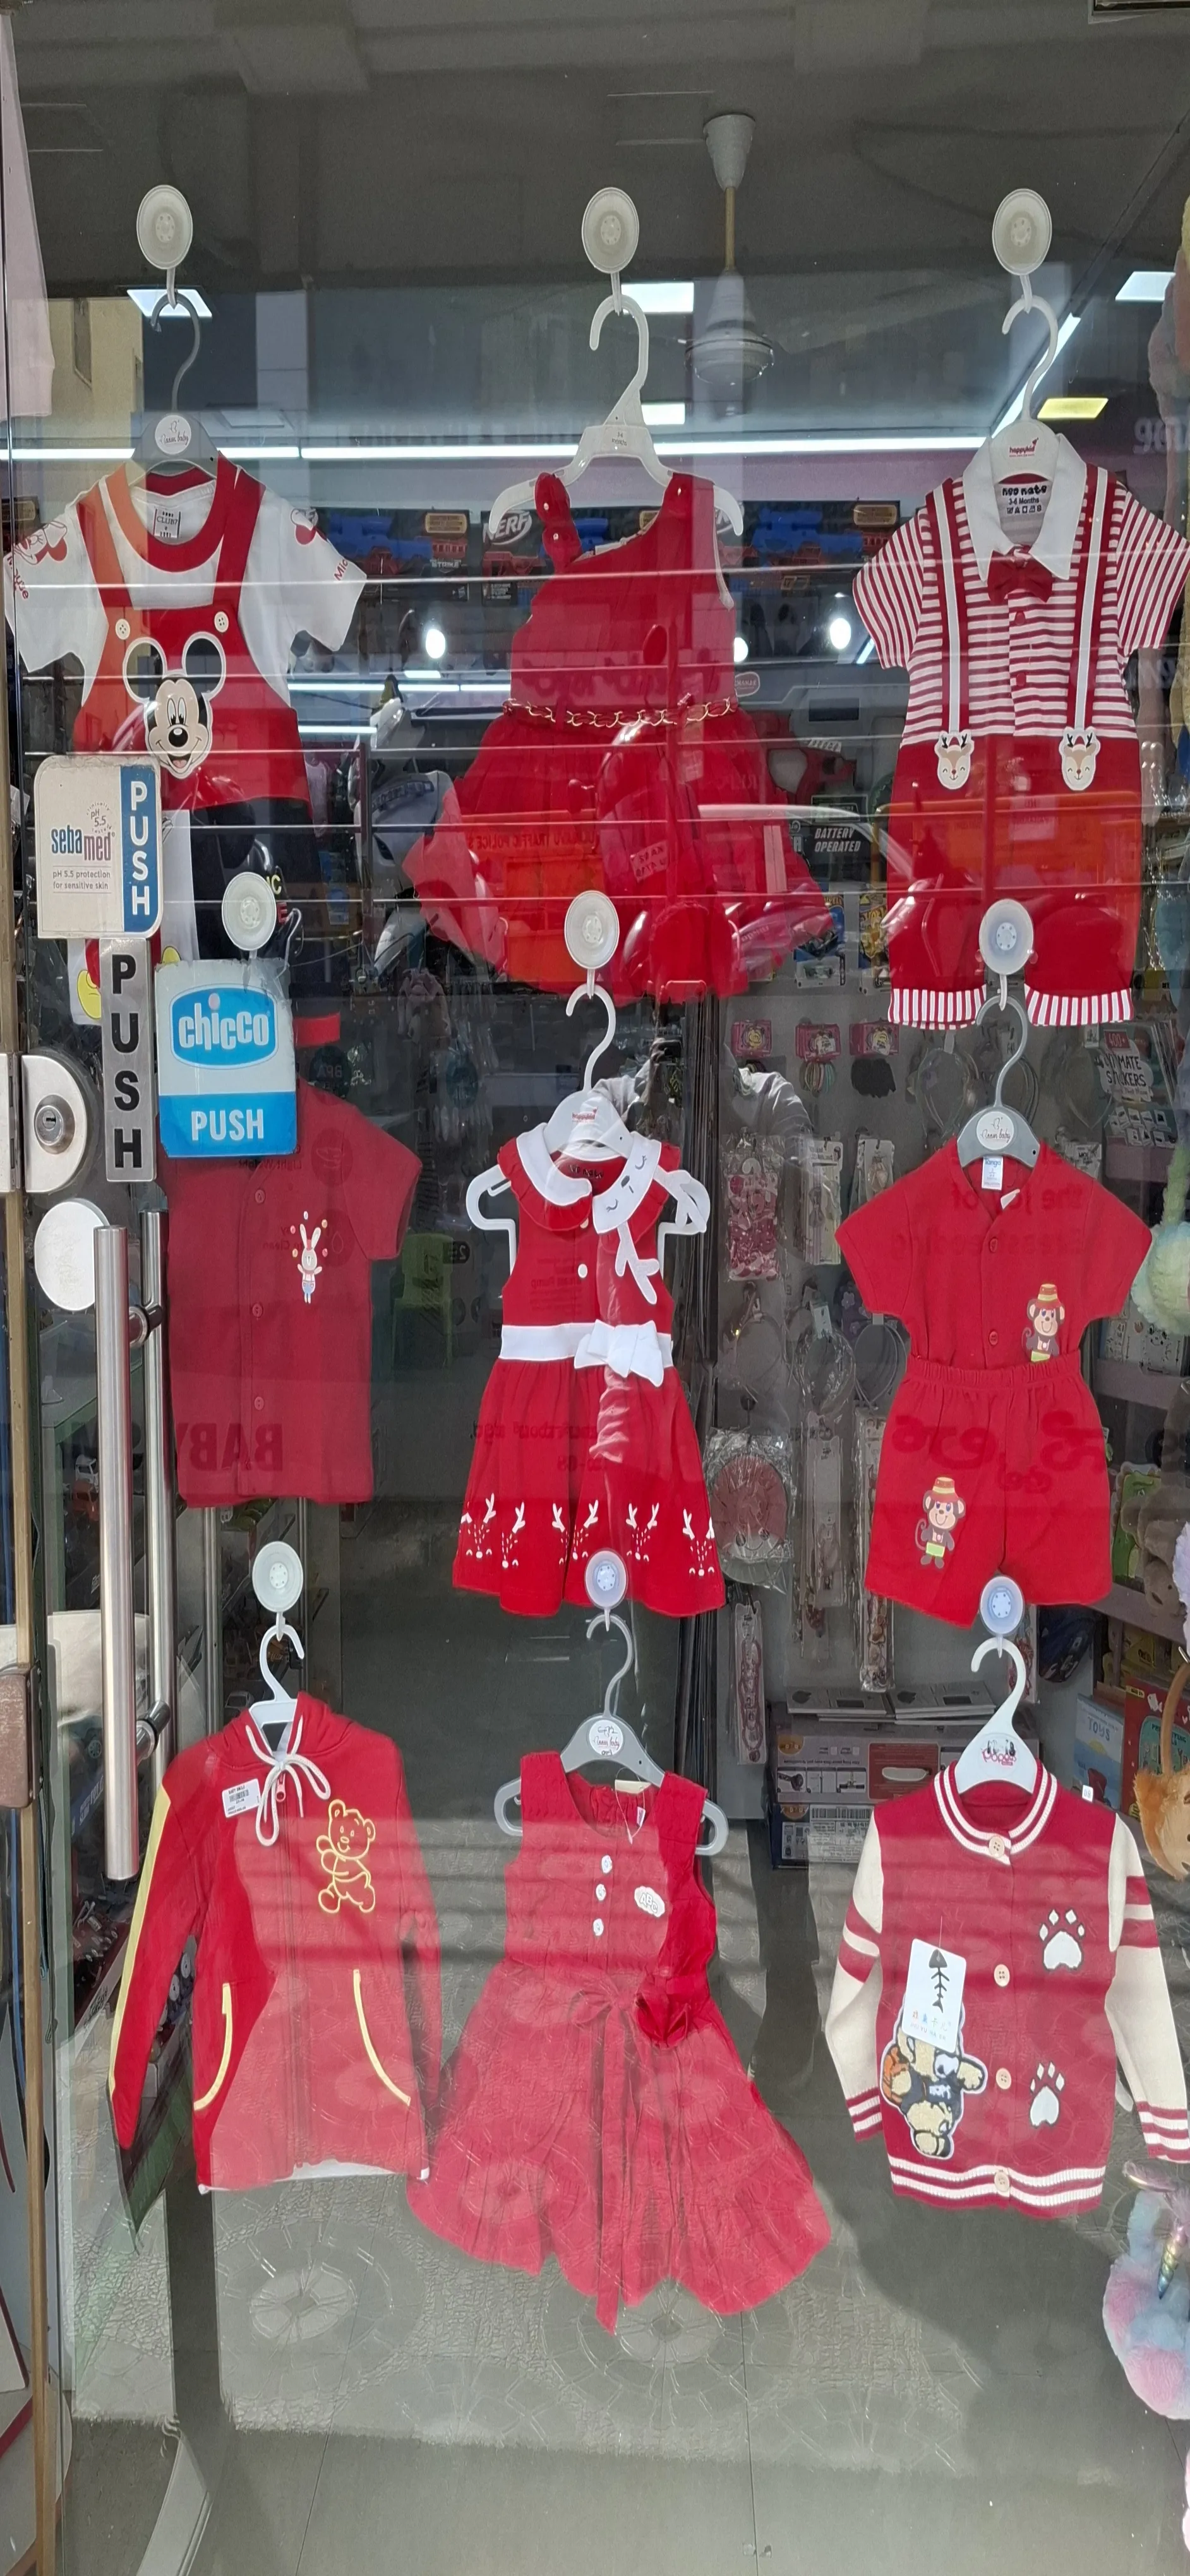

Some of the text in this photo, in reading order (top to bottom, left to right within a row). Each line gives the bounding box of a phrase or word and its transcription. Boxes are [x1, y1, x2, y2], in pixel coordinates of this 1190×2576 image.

[483, 511, 530, 544] NERF
[90, 809, 100, 820] pH
[94, 815, 107, 827] 5.5
[814, 828, 854, 840] BATTERY
[129, 780, 150, 915] PUSH
[814, 840, 862, 853] OPERATED
[52, 869, 111, 879] pH 5.5 protection
[53, 881, 109, 890] for sensitive skin
[179, 993, 269, 1051] chicco
[112, 954, 143, 1169] PUSH
[191, 1109, 264, 1141] PUSH
[1088, 1715, 1110, 1742] TOYS
[639, 1892, 658, 1914] ABC
